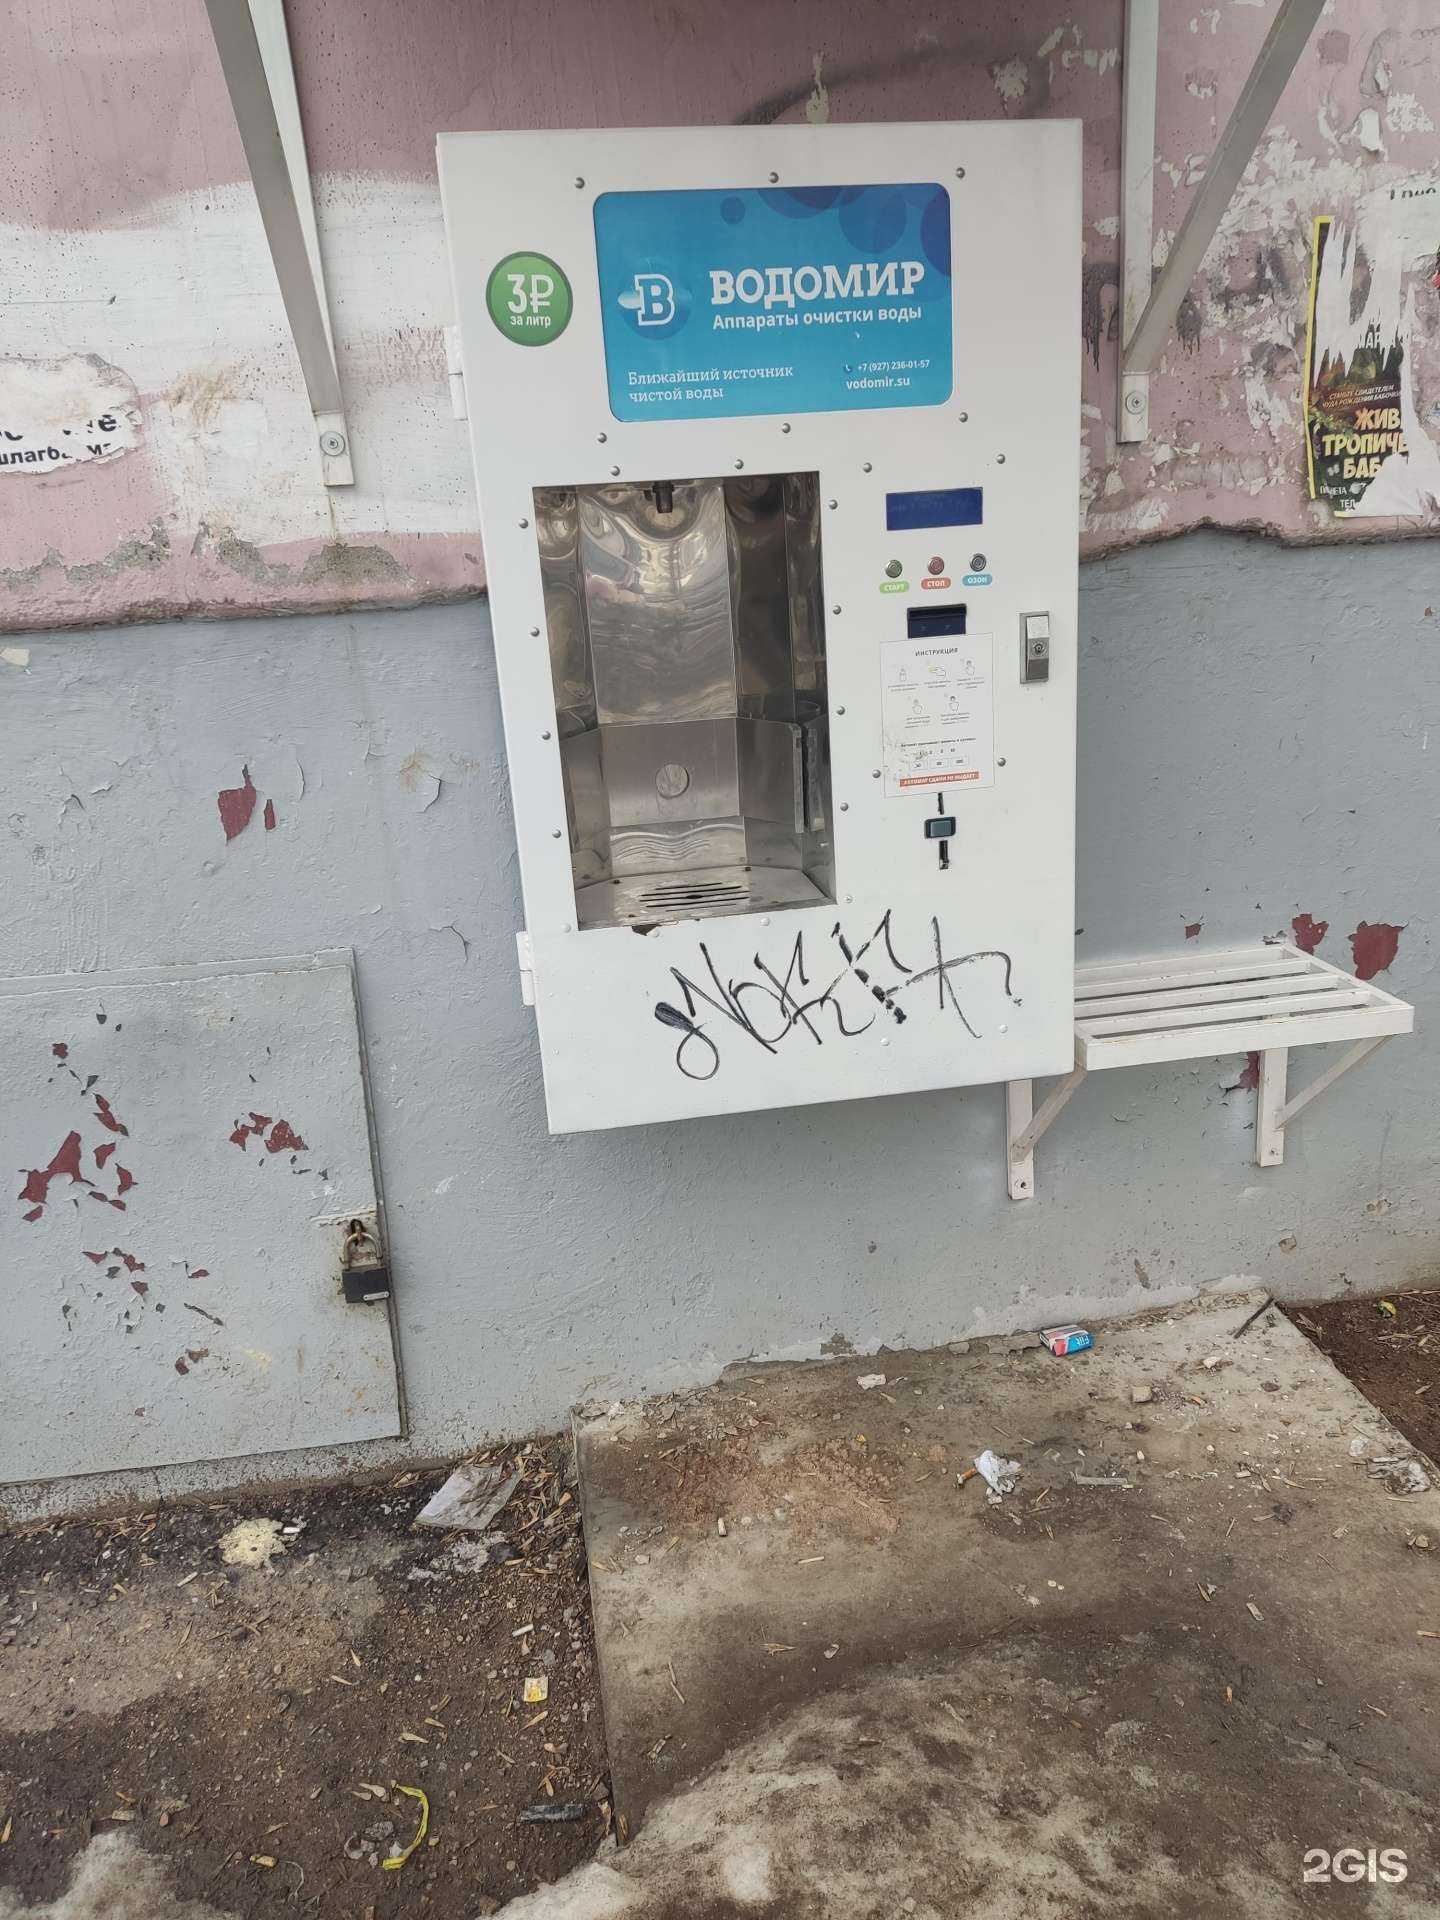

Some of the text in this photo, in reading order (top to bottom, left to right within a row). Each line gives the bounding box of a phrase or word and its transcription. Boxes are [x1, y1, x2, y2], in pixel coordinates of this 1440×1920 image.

[709, 261, 925, 310] ВОДОМИР
[510, 315, 551, 328] за литр
[713, 306, 922, 332] Аппараты очистки воды
[628, 366, 794, 385] Ближайший источник
[846, 376, 910, 390] vodomir.su
[629, 386, 724, 402] чистой воды
[915, 647, 958, 656] ИНСТРУКЦИЯ
